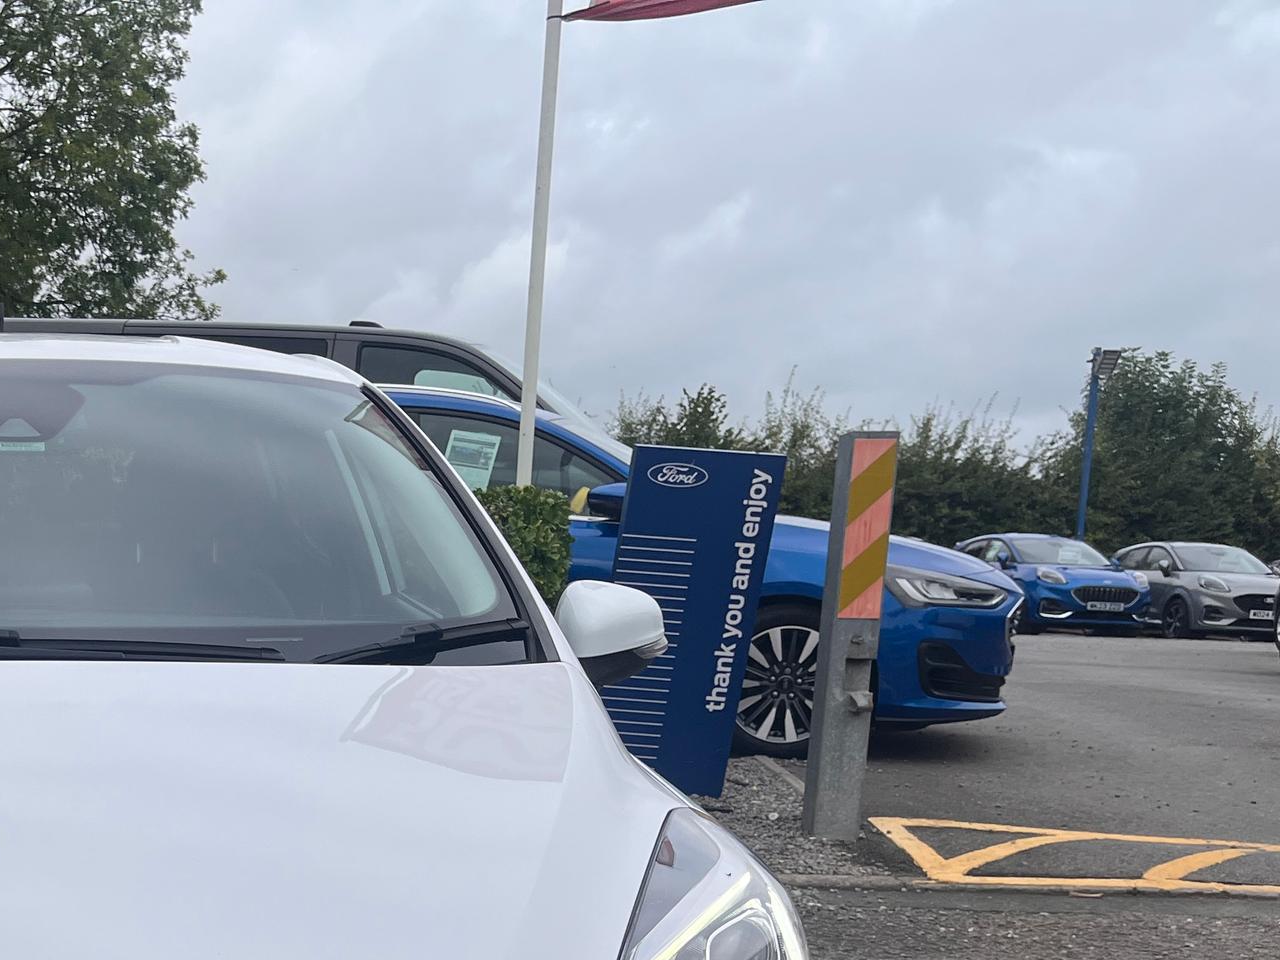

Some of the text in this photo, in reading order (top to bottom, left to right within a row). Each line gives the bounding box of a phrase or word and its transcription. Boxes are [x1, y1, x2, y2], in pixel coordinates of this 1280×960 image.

[657, 466, 698, 485] Ford
[705, 468, 773, 713] thank you and enjoy
